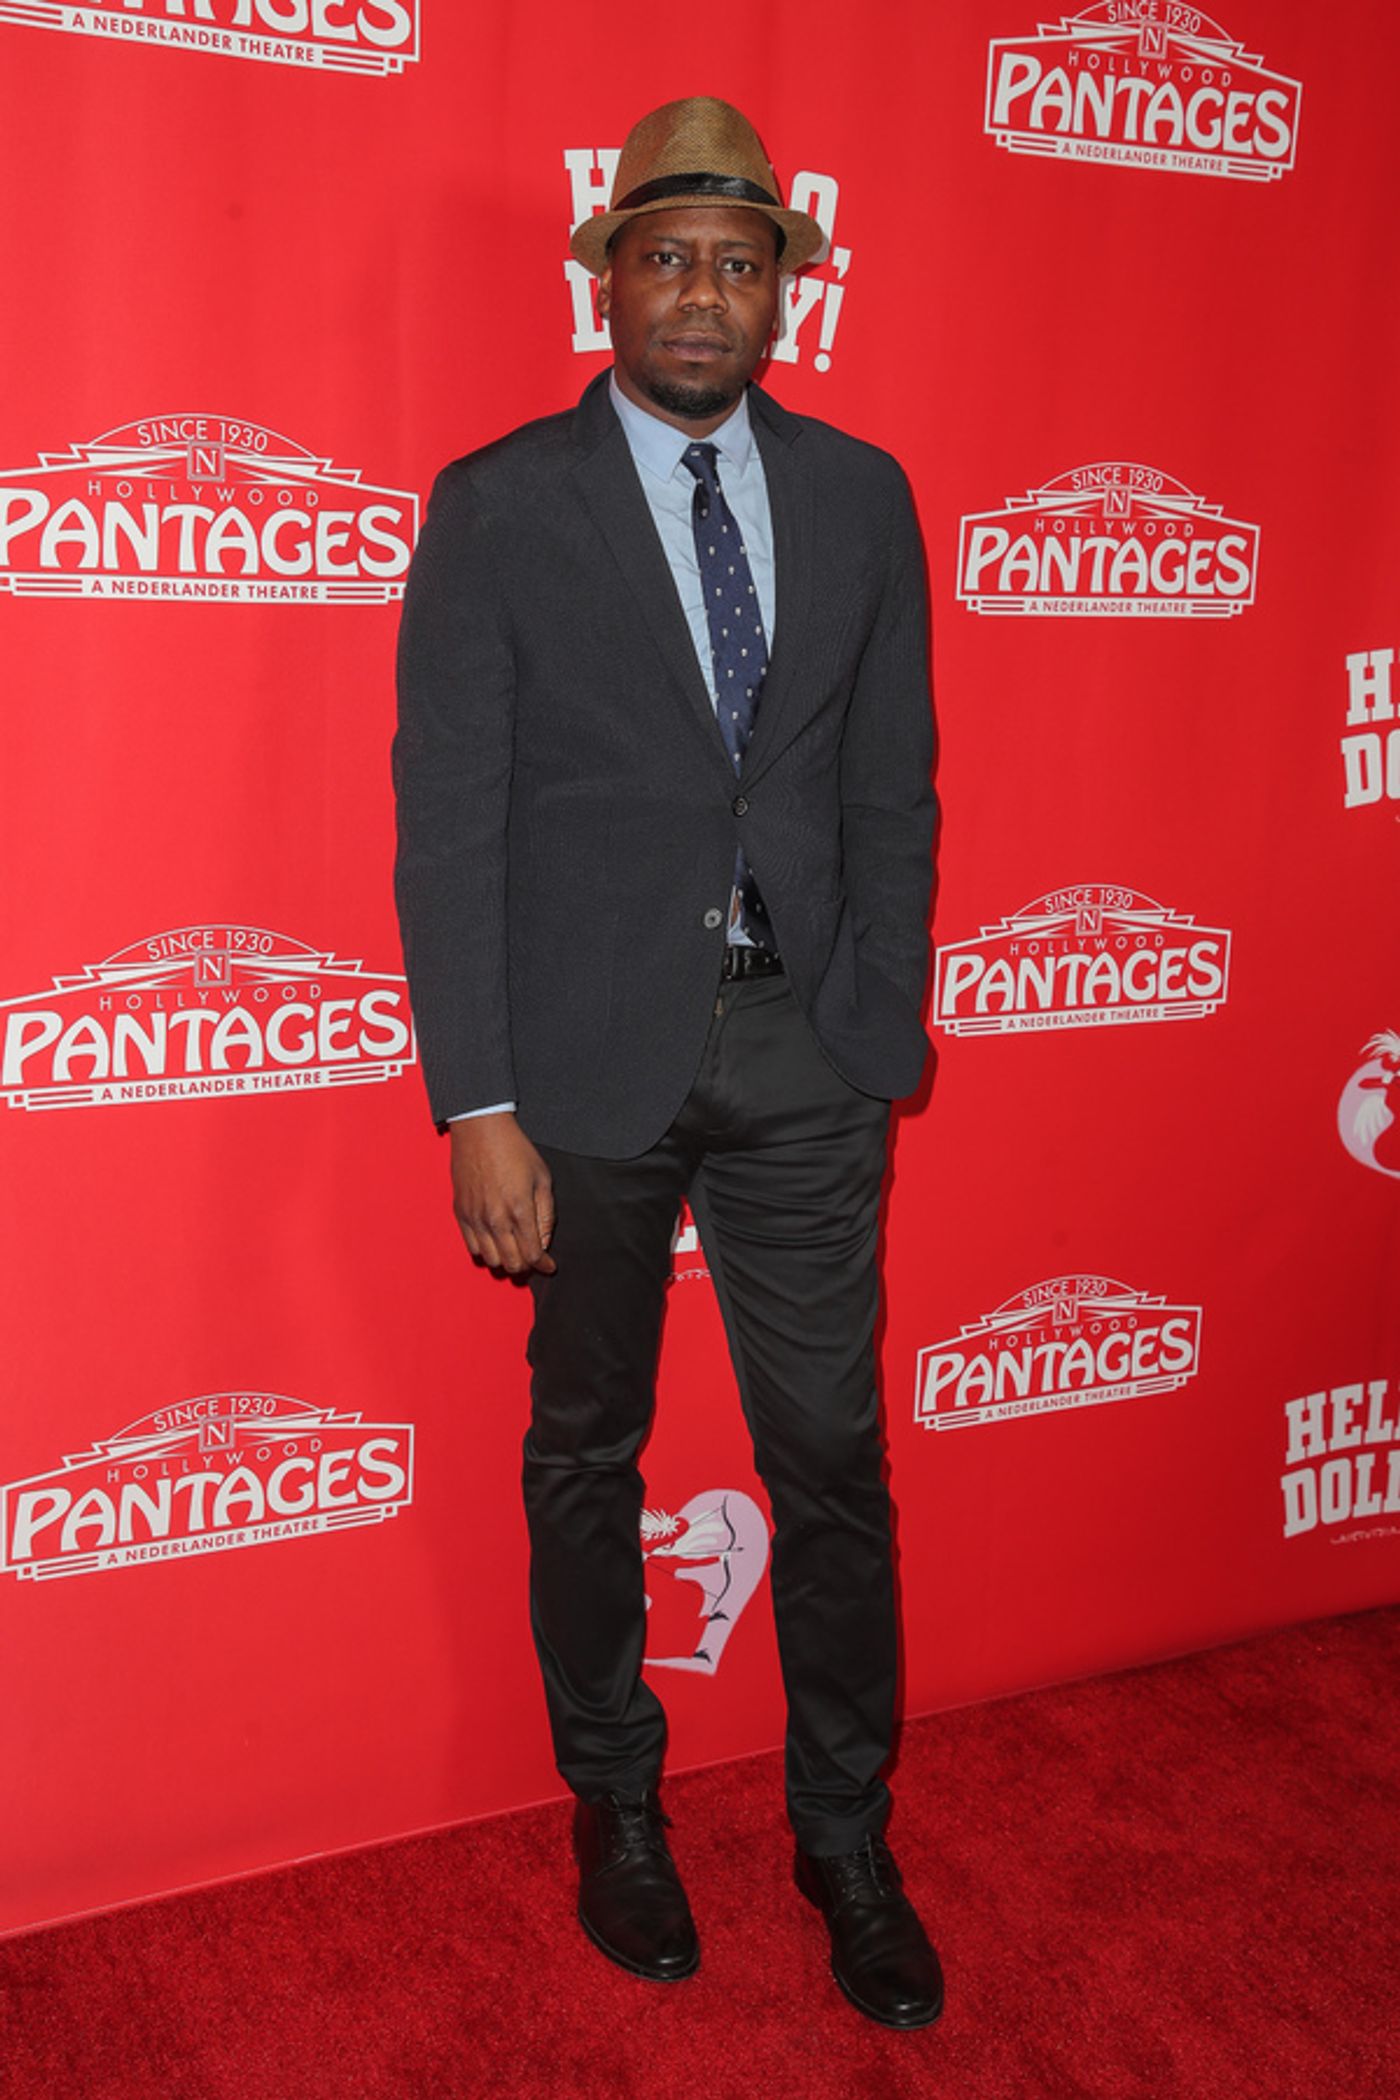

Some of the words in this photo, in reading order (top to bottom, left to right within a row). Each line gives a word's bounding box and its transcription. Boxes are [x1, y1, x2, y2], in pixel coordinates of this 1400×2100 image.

[1107, 1, 1158, 23] SINCE
[1166, 5, 1201, 34] 1930
[72, 13, 85, 27] A
[93, 17, 232, 50] NEDERLANDER
[240, 38, 315, 62] THEATRE
[1145, 28, 1162, 50] N
[1068, 51, 1232, 87] HOLLYWOOD
[993, 52, 1291, 158] PANTAGES
[1062, 143, 1072, 154] A
[1076, 144, 1167, 165] NEDERLANDER
[1172, 155, 1223, 171] THEATRE
[137, 420, 208, 446] SINCE
[219, 422, 267, 452] 1930
[195, 448, 217, 474] N
[88, 480, 319, 506] HOLLYWOOD
[1072, 467, 1121, 491] SINCE
[1129, 469, 1163, 491] 1930
[1109, 492, 1125, 512] N
[0, 488, 410, 577] PANTAGES
[1035, 519, 1194, 537] HOLLYWOOD
[964, 526, 1250, 596] PANTAGES
[91, 580, 103, 593] A
[112, 581, 240, 598] NEDERLANDER
[248, 584, 319, 599] THEATRE
[1029, 601, 1038, 611] A
[1043, 601, 1132, 613] NEDERLANDER
[1137, 602, 1186, 613] THEATRE
[1346, 648, 1400, 726] H
[1045, 889, 1092, 914] SINCE
[1100, 890, 1133, 907] 1930
[1081, 911, 1097, 930] N
[146, 931, 215, 961] SINCE
[226, 931, 273, 953] 1930
[1010, 935, 1164, 956] HOLLYWOOD
[201, 955, 223, 979] N
[941, 941, 1222, 1016] PANTAGES
[100, 984, 322, 1011] HOLLYWOOD
[1007, 1018, 1016, 1029] A
[1020, 1012, 1105, 1028] NEDERLANDER
[1110, 1008, 1159, 1022] THEATRE
[3, 990, 409, 1086] PANTAGES
[101, 1086, 113, 1100] A
[122, 1078, 245, 1098] NEDERLANDER
[252, 1072, 322, 1089] THEATRE
[1024, 1280, 1069, 1308] SINCE
[1076, 1279, 1108, 1296] 1930
[1057, 1302, 1073, 1319] N
[990, 1316, 1138, 1350] HOLLYWOOD
[922, 1318, 1194, 1412] PANTAGES
[153, 1400, 219, 1432] SINCE
[230, 1398, 276, 1416] 1930
[985, 1408, 994, 1418] A
[998, 1394, 1080, 1417] NEDERLANDER
[1084, 1385, 1132, 1402] THEATRE
[206, 1423, 228, 1445] N
[1285, 1380, 1400, 1465] HEL
[107, 1438, 322, 1484] HOLLYWOOD
[12, 1438, 406, 1561] PANTAGES
[107, 1552, 118, 1566] A
[126, 1531, 245, 1564] NEDERLANDER
[253, 1518, 320, 1542] THEATRE
